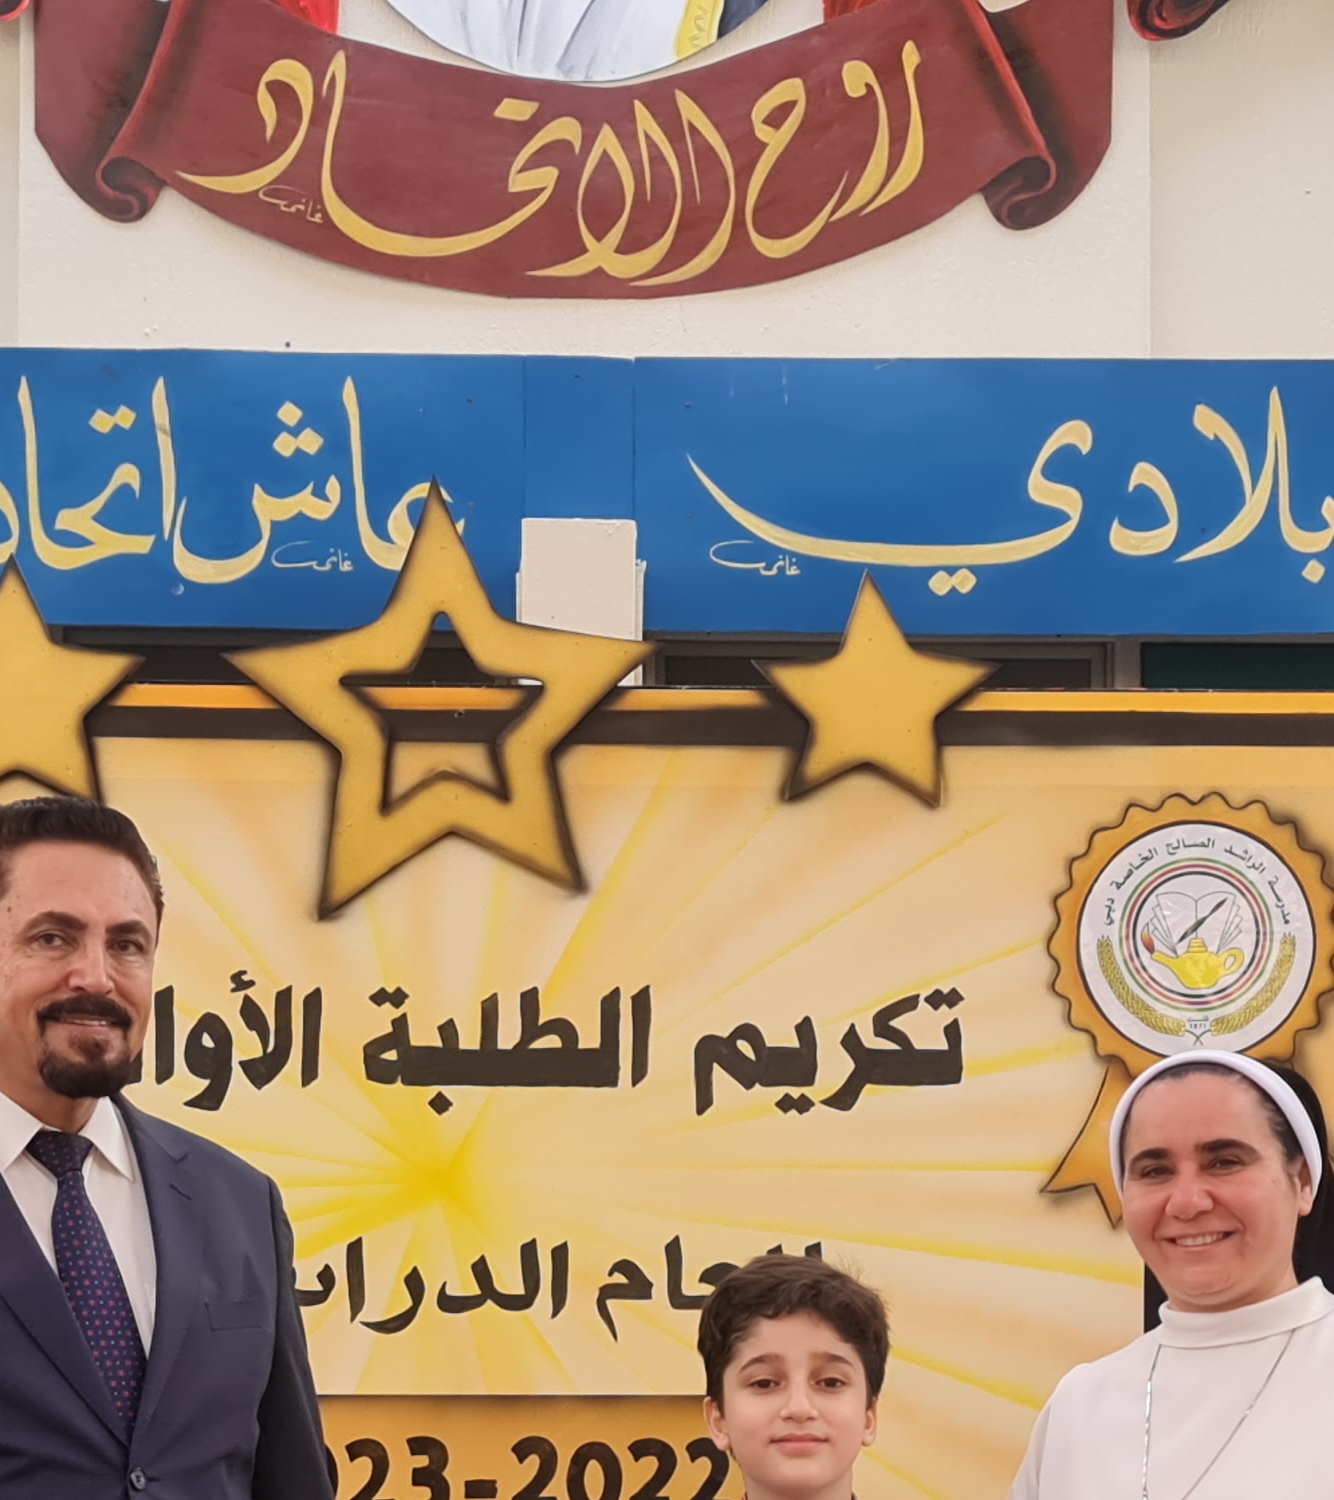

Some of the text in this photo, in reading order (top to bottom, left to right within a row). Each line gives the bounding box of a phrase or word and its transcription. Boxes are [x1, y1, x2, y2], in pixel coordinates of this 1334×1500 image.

[176, 40, 924, 286] روح الاتحاد
[174, 376, 465, 584] عاش
[1224, 845, 1267, 874] الراشد
[1268, 875, 1291, 925] مدرسة
[129, 969, 963, 1116] تكريم الطلبة الأوا
